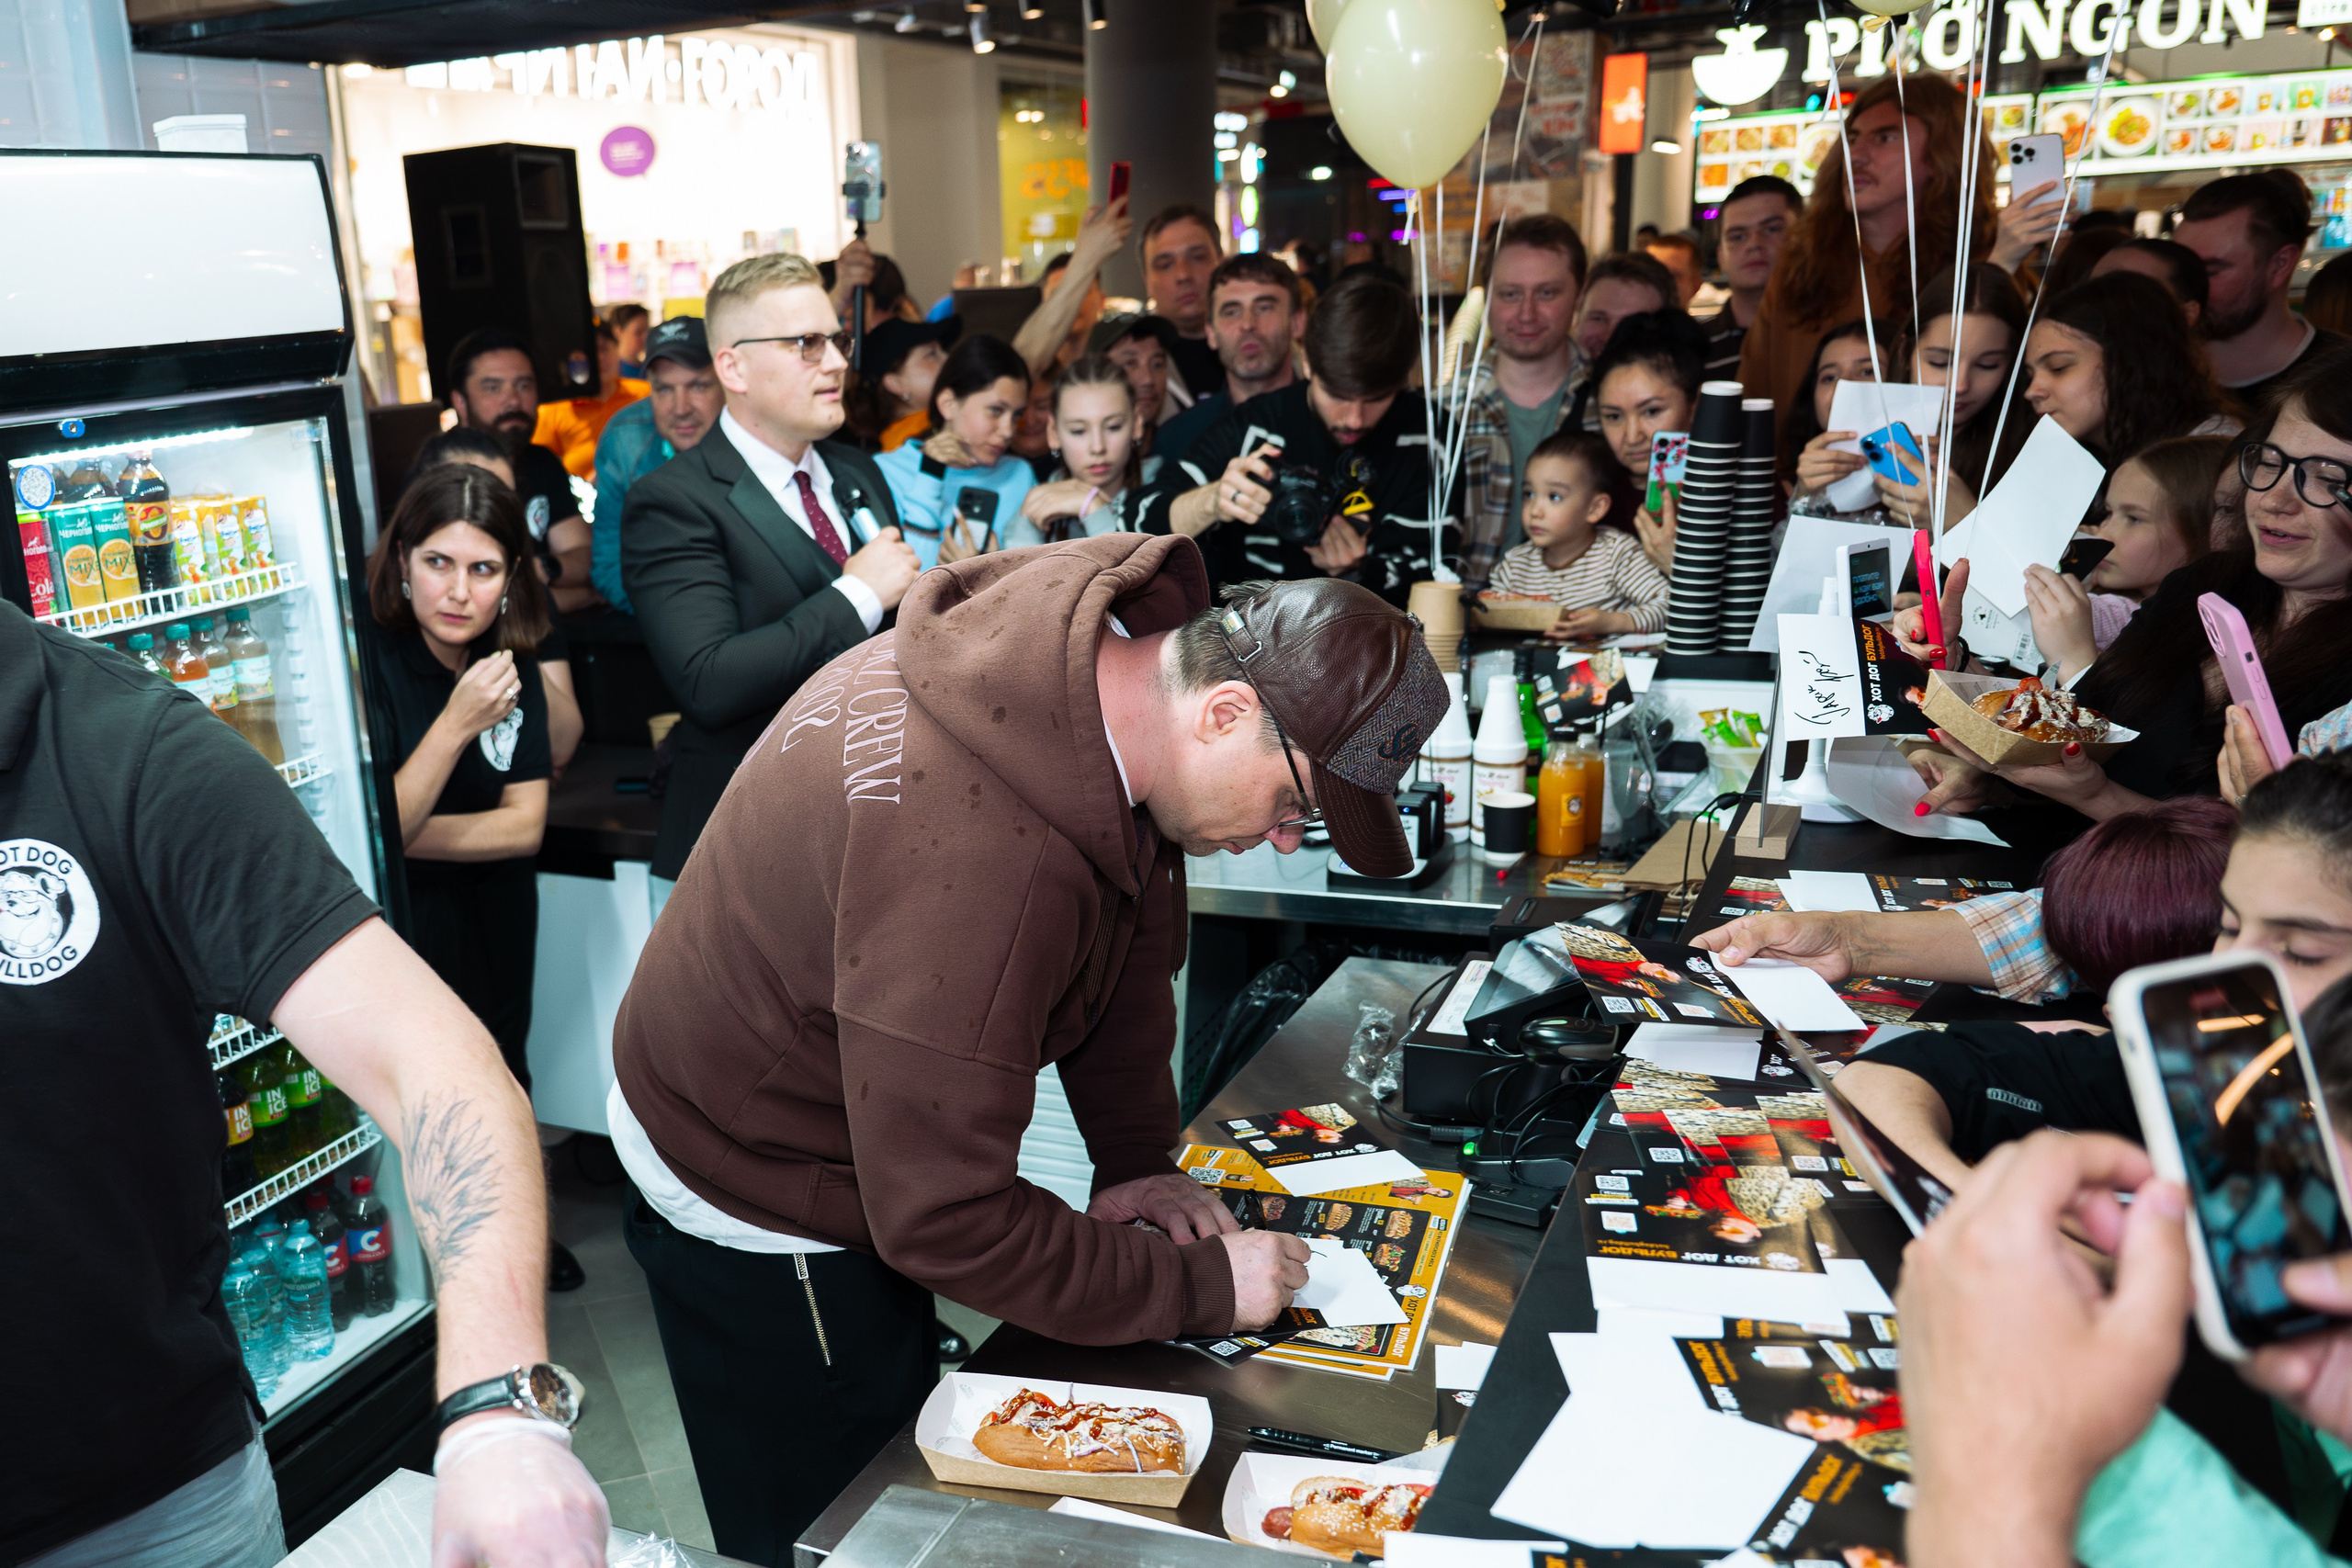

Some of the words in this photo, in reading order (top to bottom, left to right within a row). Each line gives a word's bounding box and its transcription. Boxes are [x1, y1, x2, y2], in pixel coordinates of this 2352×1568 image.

[1999, 0, 2267, 63] NGON
[1861, 624, 1877, 661] БУЛЬДОГ
[1867, 662, 1880, 682] ДОГ
[1869, 682, 1883, 702] ХОТ
[842, 687, 910, 806] CREW
[27, 846, 74, 874] DOG
[303, 1069, 316, 1084] IN
[266, 1087, 281, 1103] IN
[305, 1078, 321, 1096] ICE
[233, 1103, 248, 1122] IN
[268, 1096, 288, 1115] ICE
[235, 1116, 253, 1134] ICE
[1267, 1153, 1312, 1166] БУЛЬДОГ
[1313, 1150, 1332, 1159] ДОГ
[1335, 1147, 1356, 1156] ХОТ
[1598, 1246, 1679, 1259] БУЛЬДОГ
[1681, 1252, 1719, 1263] ДОГ
[1724, 1254, 1761, 1266] ХОТ
[1407, 1298, 1419, 1313] ХОТ
[1392, 1326, 1410, 1358] БУЛЬДОГ
[1329, 1443, 1356, 1453] Permanent
